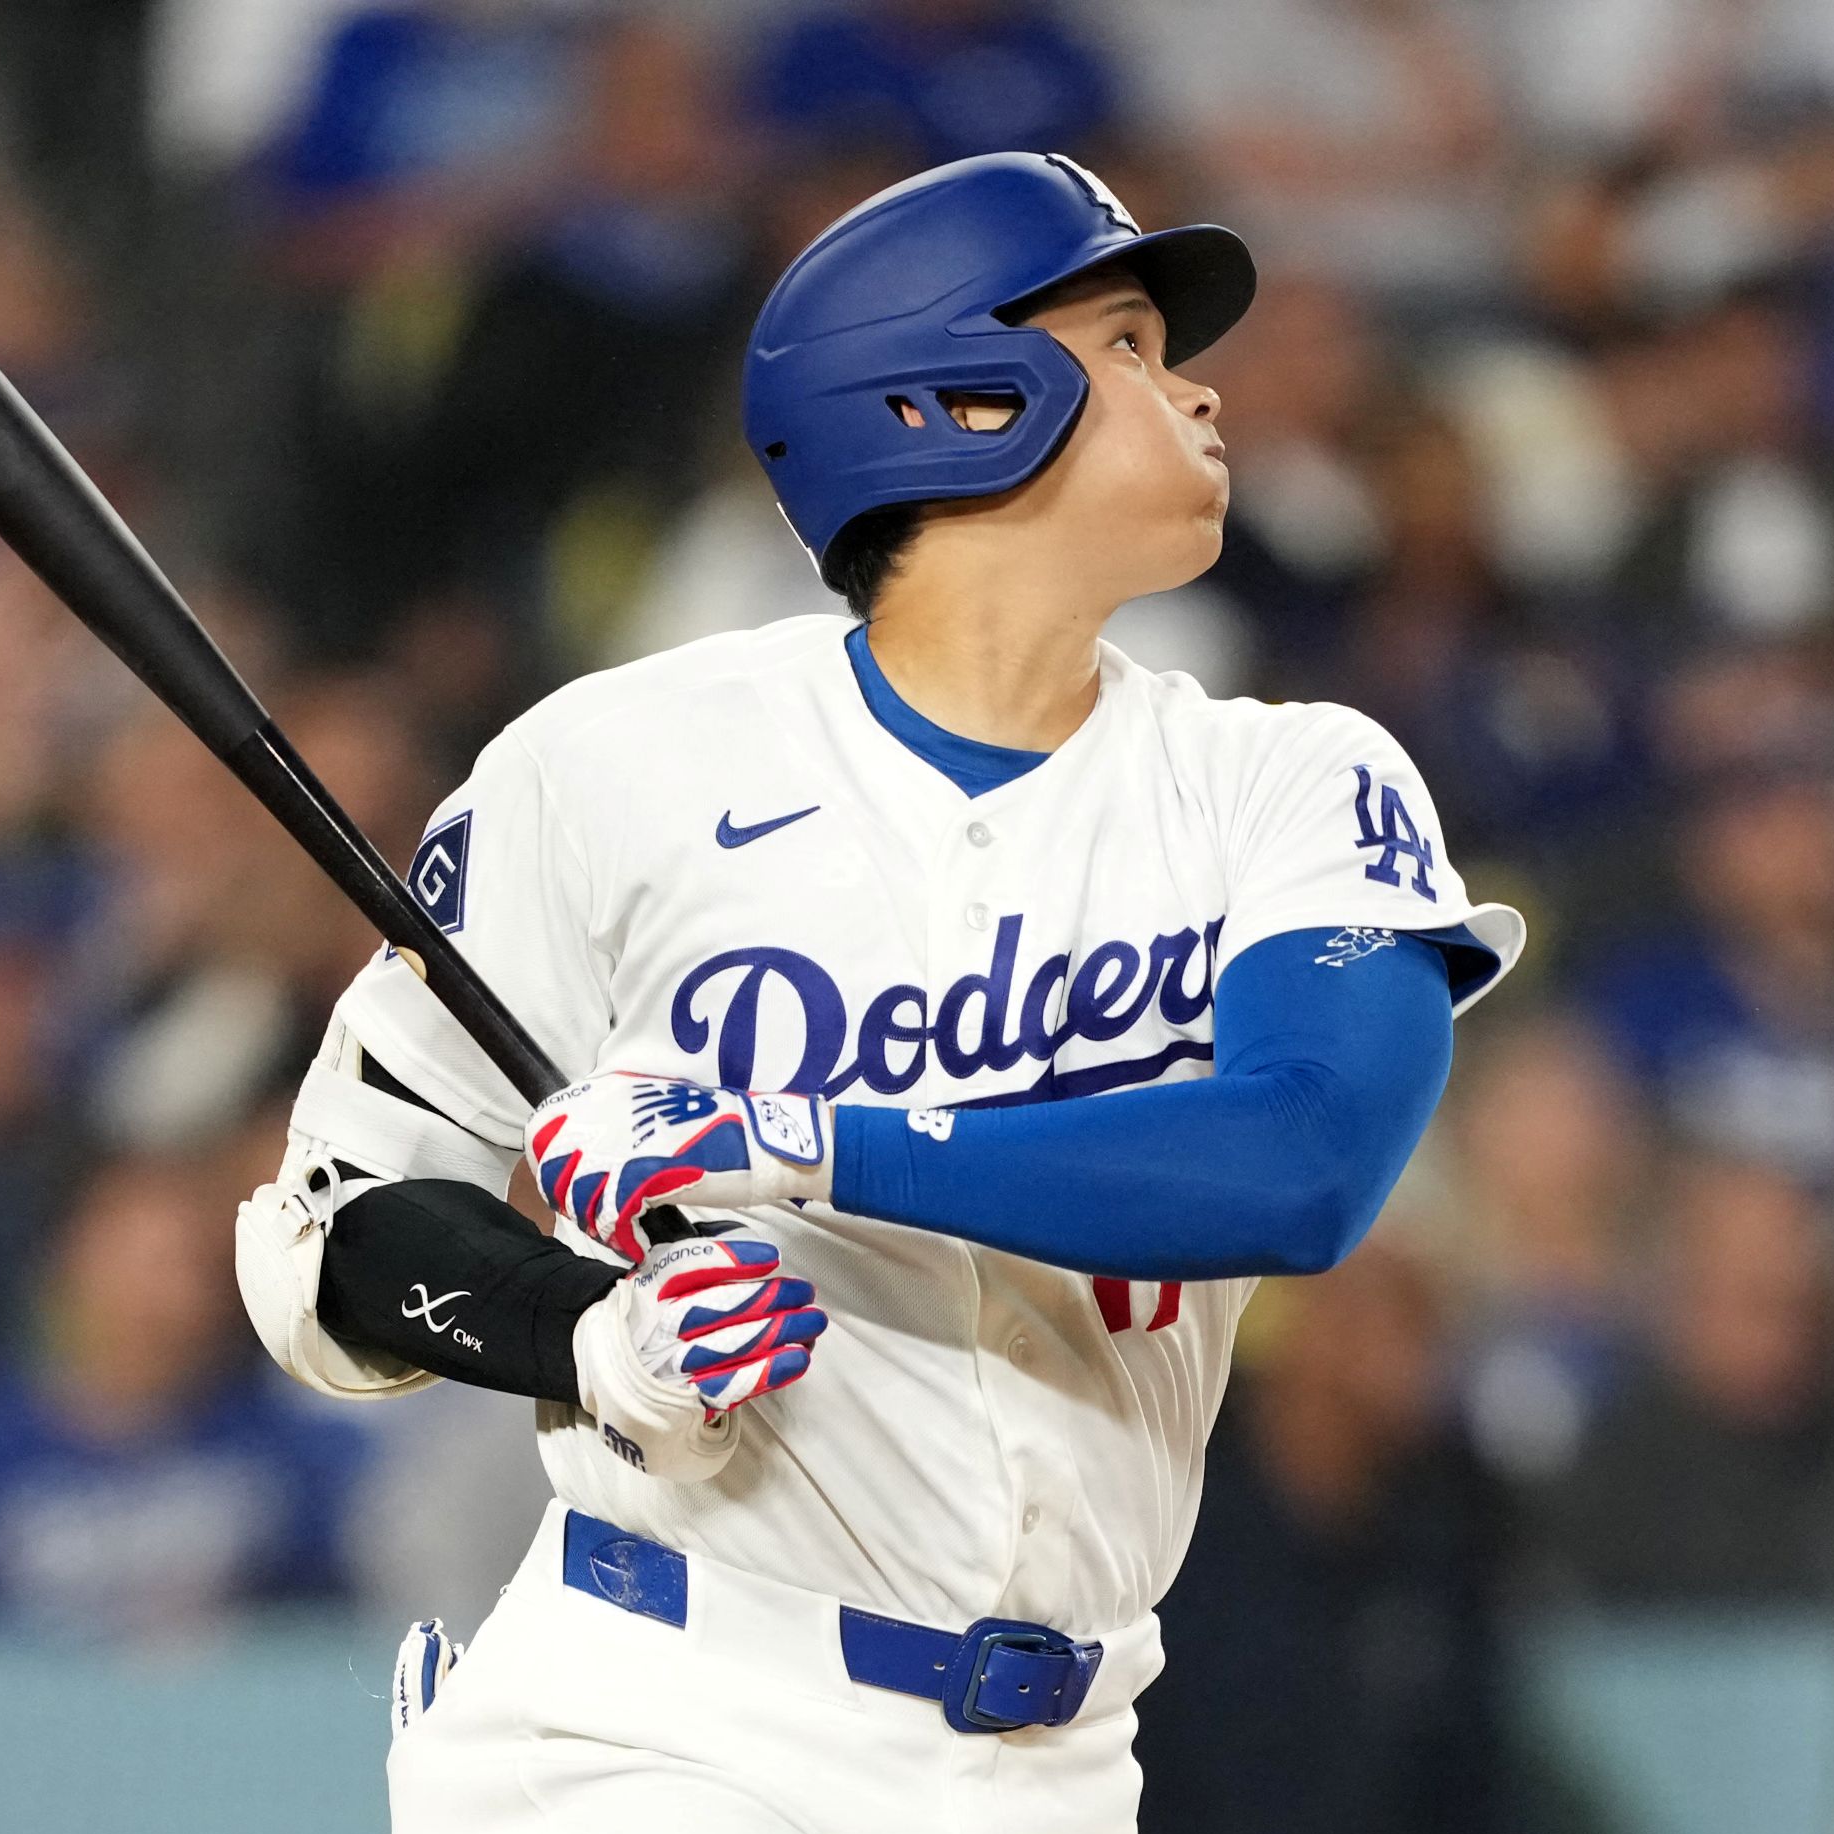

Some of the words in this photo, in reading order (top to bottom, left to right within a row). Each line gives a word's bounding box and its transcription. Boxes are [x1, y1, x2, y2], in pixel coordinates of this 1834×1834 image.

[1351, 764, 1437, 903] LA
[417, 843, 457, 906] G
[528, 1083, 591, 1122] alance
[634, 1272, 654, 1288] new
[653, 1246, 714, 1276] balance
[452, 1328, 484, 1353] CW-X
